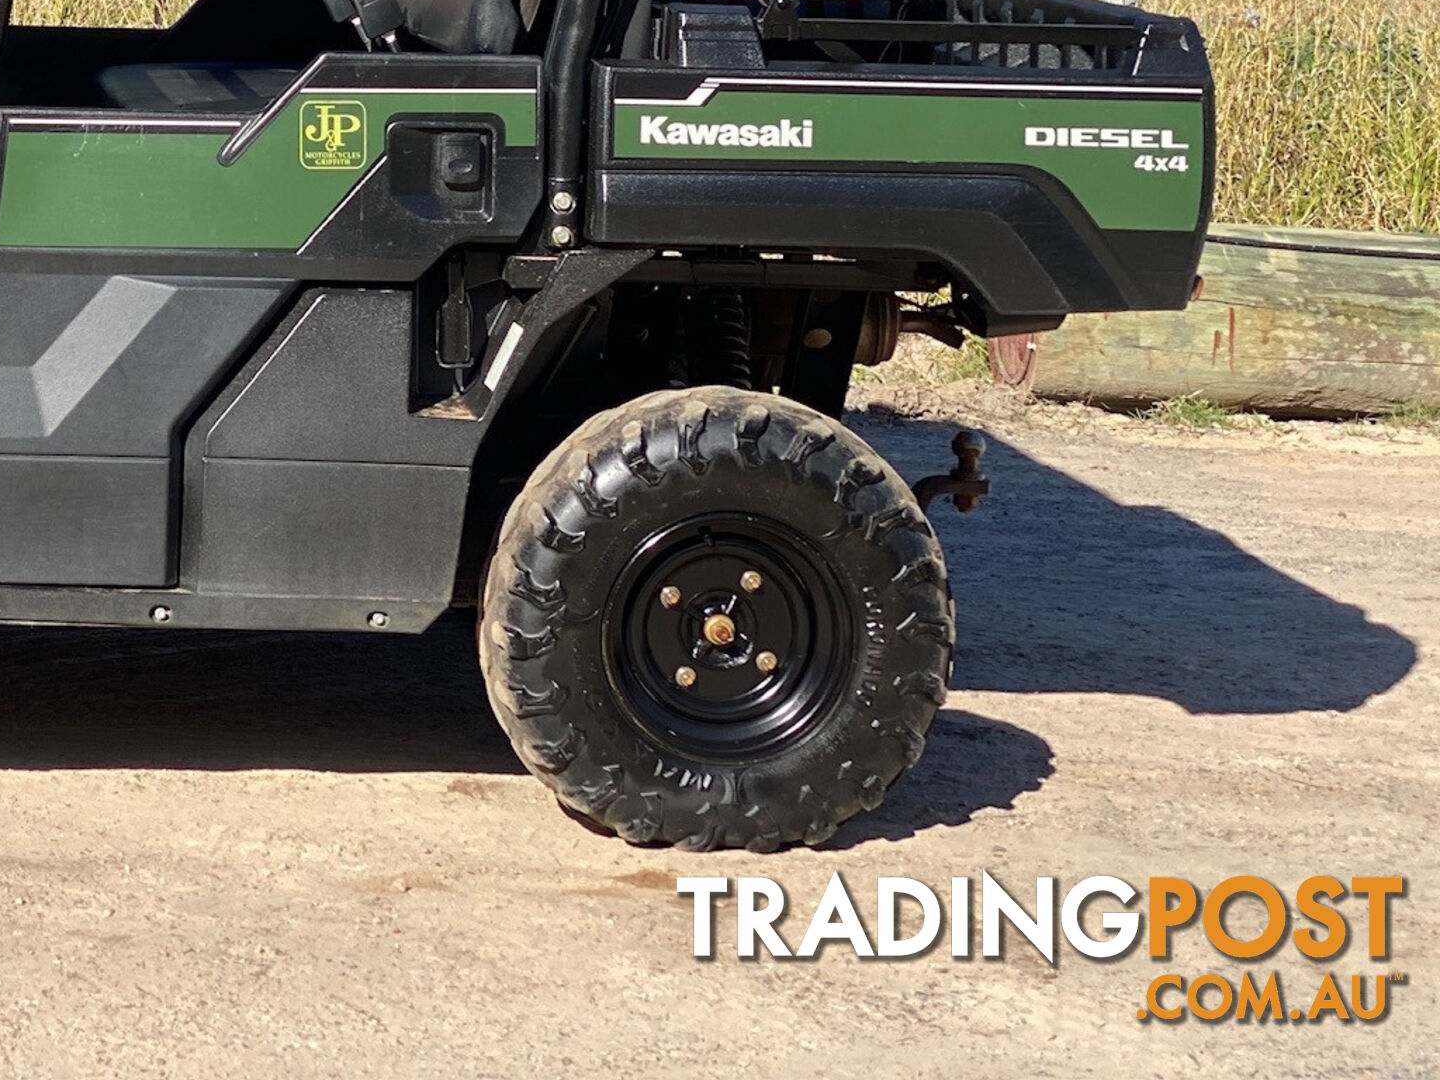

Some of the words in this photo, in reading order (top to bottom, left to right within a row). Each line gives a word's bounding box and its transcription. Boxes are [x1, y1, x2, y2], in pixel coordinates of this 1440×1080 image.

[640, 115, 813, 148] Kawasaki
[1024, 126, 1190, 149] DIESEL
[304, 151, 361, 159] MOTORCYCLES
[1133, 154, 1189, 172] 4x4
